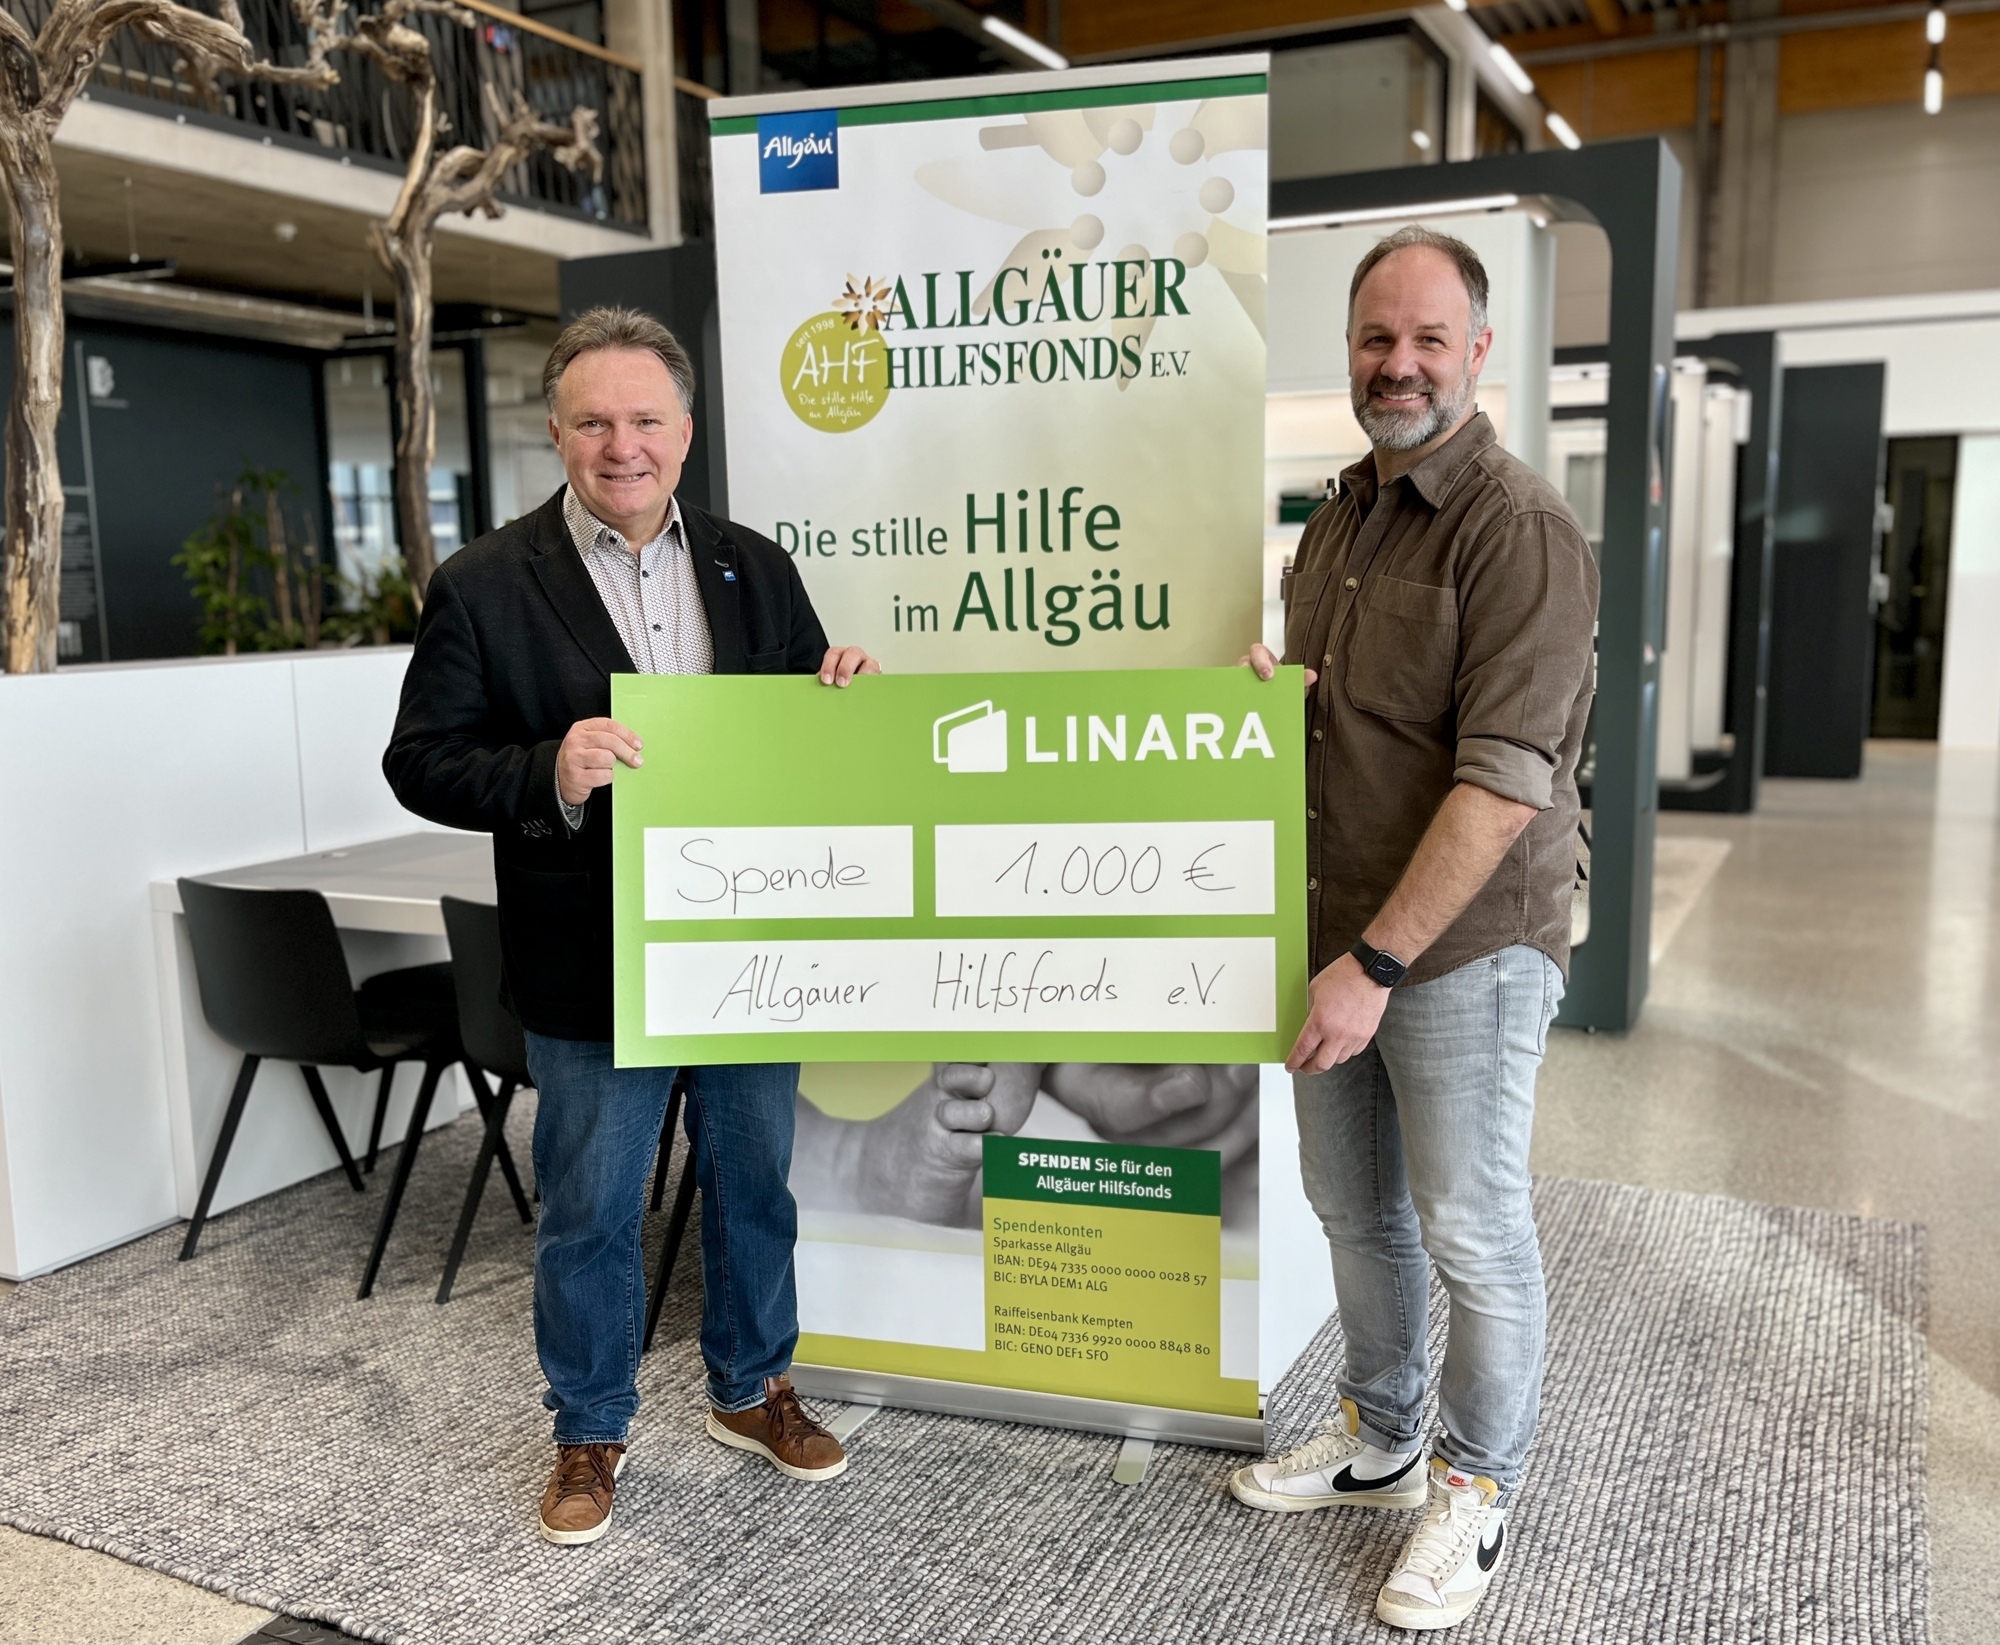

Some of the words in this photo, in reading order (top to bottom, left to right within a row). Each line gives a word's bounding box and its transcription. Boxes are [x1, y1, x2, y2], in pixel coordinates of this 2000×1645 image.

[763, 132, 834, 169] Allgäu
[882, 247, 1192, 332] ALLGÄUER
[796, 331, 811, 348] seit
[811, 319, 834, 334] 1998
[792, 338, 880, 391] AHF
[883, 334, 1143, 390] HILFSFONDS
[1149, 350, 1192, 378] E.V.
[799, 393, 816, 405] Die
[821, 391, 847, 406] stille
[851, 389, 875, 405] Hilfe
[808, 407, 822, 419] im
[827, 405, 861, 424] Allgäu
[775, 519, 837, 558] Die
[851, 516, 948, 557] stille
[965, 486, 1121, 554] Hilfe
[893, 594, 939, 632] im
[952, 566, 1171, 647] Allgäu
[1024, 711, 1276, 764] LINARA
[677, 838, 872, 915] Spende
[995, 841, 1162, 896] 1.000
[1182, 843, 1237, 892] €
[712, 954, 880, 1023] Allgäuer
[933, 950, 1119, 1014] Hilfsfonds
[1167, 962, 1226, 1006] e.V.
[1017, 1152, 1091, 1171] SPENDEN
[1094, 1158, 1118, 1173] Sie
[1121, 1159, 1141, 1175] für
[1145, 1161, 1173, 1178] den
[1036, 1175, 1096, 1194] Allgäuer
[1099, 1180, 1173, 1200] Hilfsfonds
[993, 1217, 1103, 1238] Spendenkonten
[993, 1237, 1052, 1251] Sparkasse
[1055, 1241, 1092, 1257] Allgäu
[993, 1253, 1025, 1268] IBAN:
[1028, 1257, 1058, 1273] DE94
[1060, 1261, 1088, 1275] 7335
[1091, 1264, 1122, 1277] 0000
[1125, 1267, 1156, 1280] 0000
[1159, 1271, 1191, 1283] 0028
[1193, 1274, 1208, 1287] 57
[993, 1271, 1017, 1284] BIC:
[1020, 1274, 1049, 1288] BYLA
[1051, 1276, 1083, 1290] DEM1
[1085, 1280, 1109, 1292] ALG
[994, 1305, 1079, 1324] Raiffeisenbank
[1082, 1315, 1133, 1330] Kempten
[994, 1322, 1026, 1336] IBAN:
[1029, 1326, 1058, 1340] DE04
[1061, 1331, 1089, 1344] 7336
[1092, 1334, 1123, 1347] 9920
[1125, 1337, 1157, 1350] 0000
[1159, 1339, 1192, 1355] 8848
[1195, 1343, 1211, 1356] 80
[994, 1339, 1018, 1353] BIC:
[1020, 1342, 1053, 1356] GENO
[1056, 1346, 1084, 1359] DEF1
[1086, 1348, 1109, 1362] SFO
